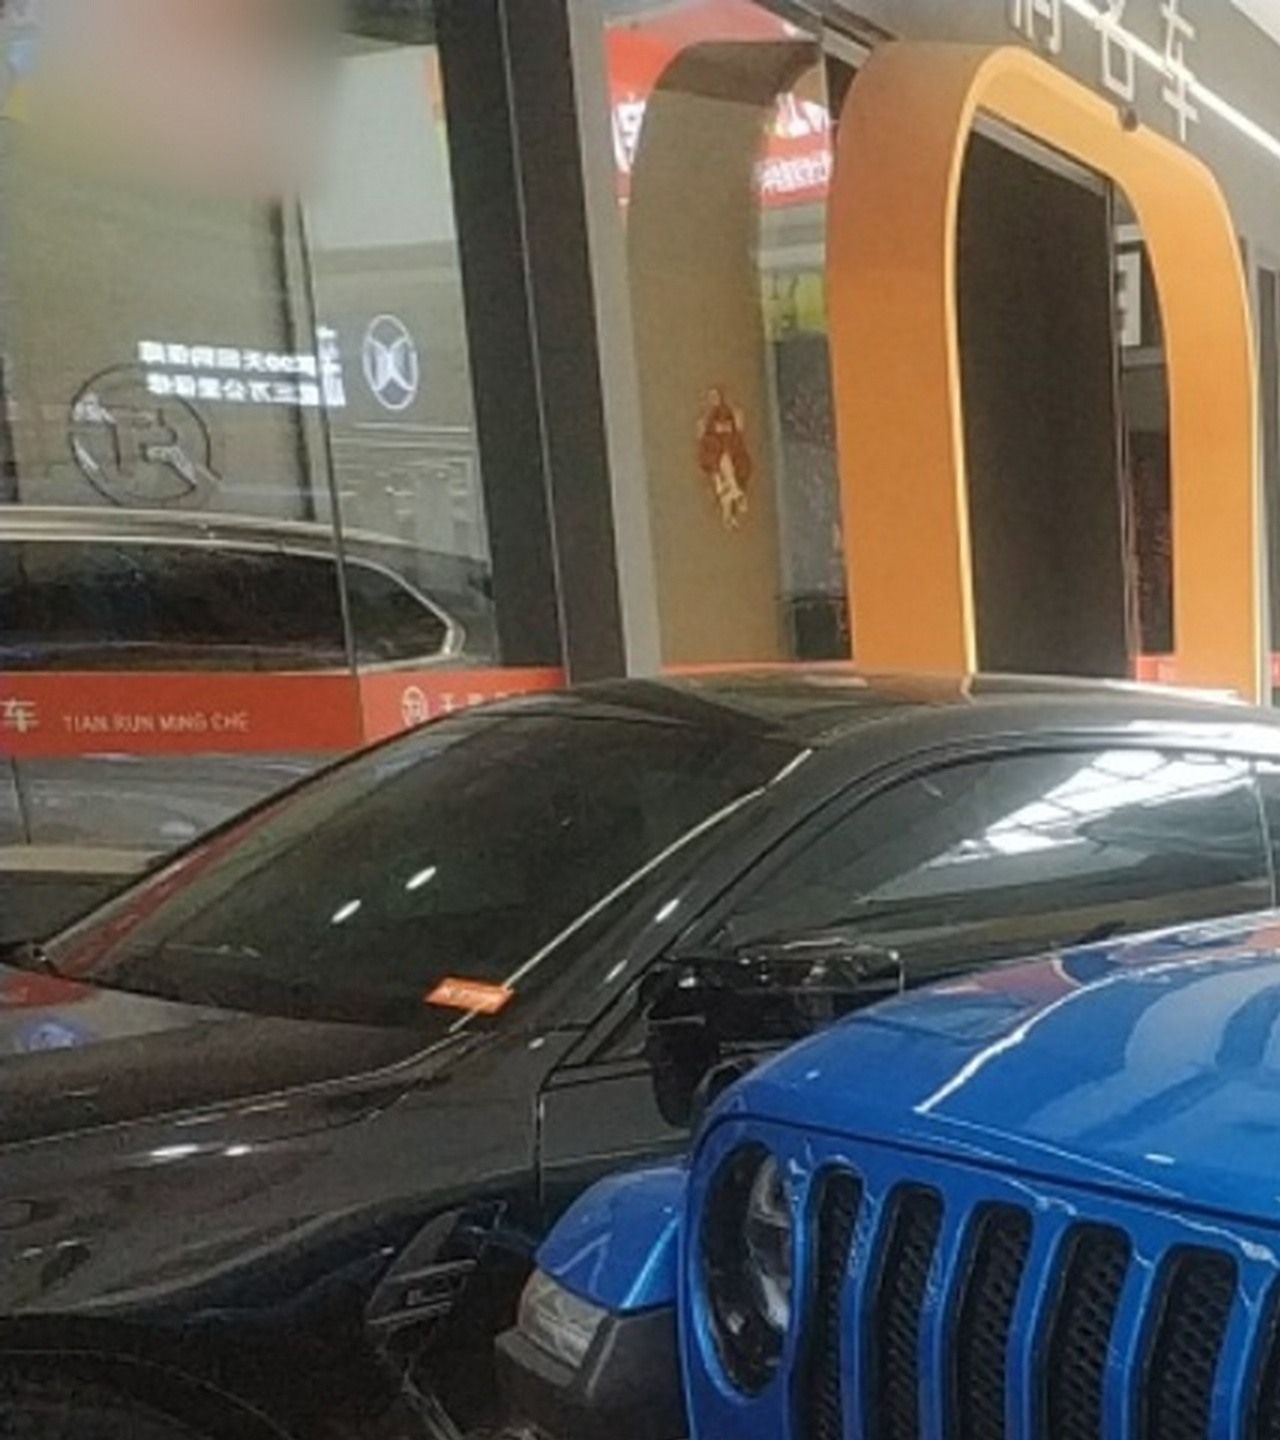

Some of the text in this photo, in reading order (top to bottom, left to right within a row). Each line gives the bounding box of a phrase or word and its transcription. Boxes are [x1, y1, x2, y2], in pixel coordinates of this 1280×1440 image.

[63, 714, 109, 733] TIAN
[112, 714, 154, 733] RUN
[159, 713, 206, 732] MING
[211, 711, 250, 731] CHE
